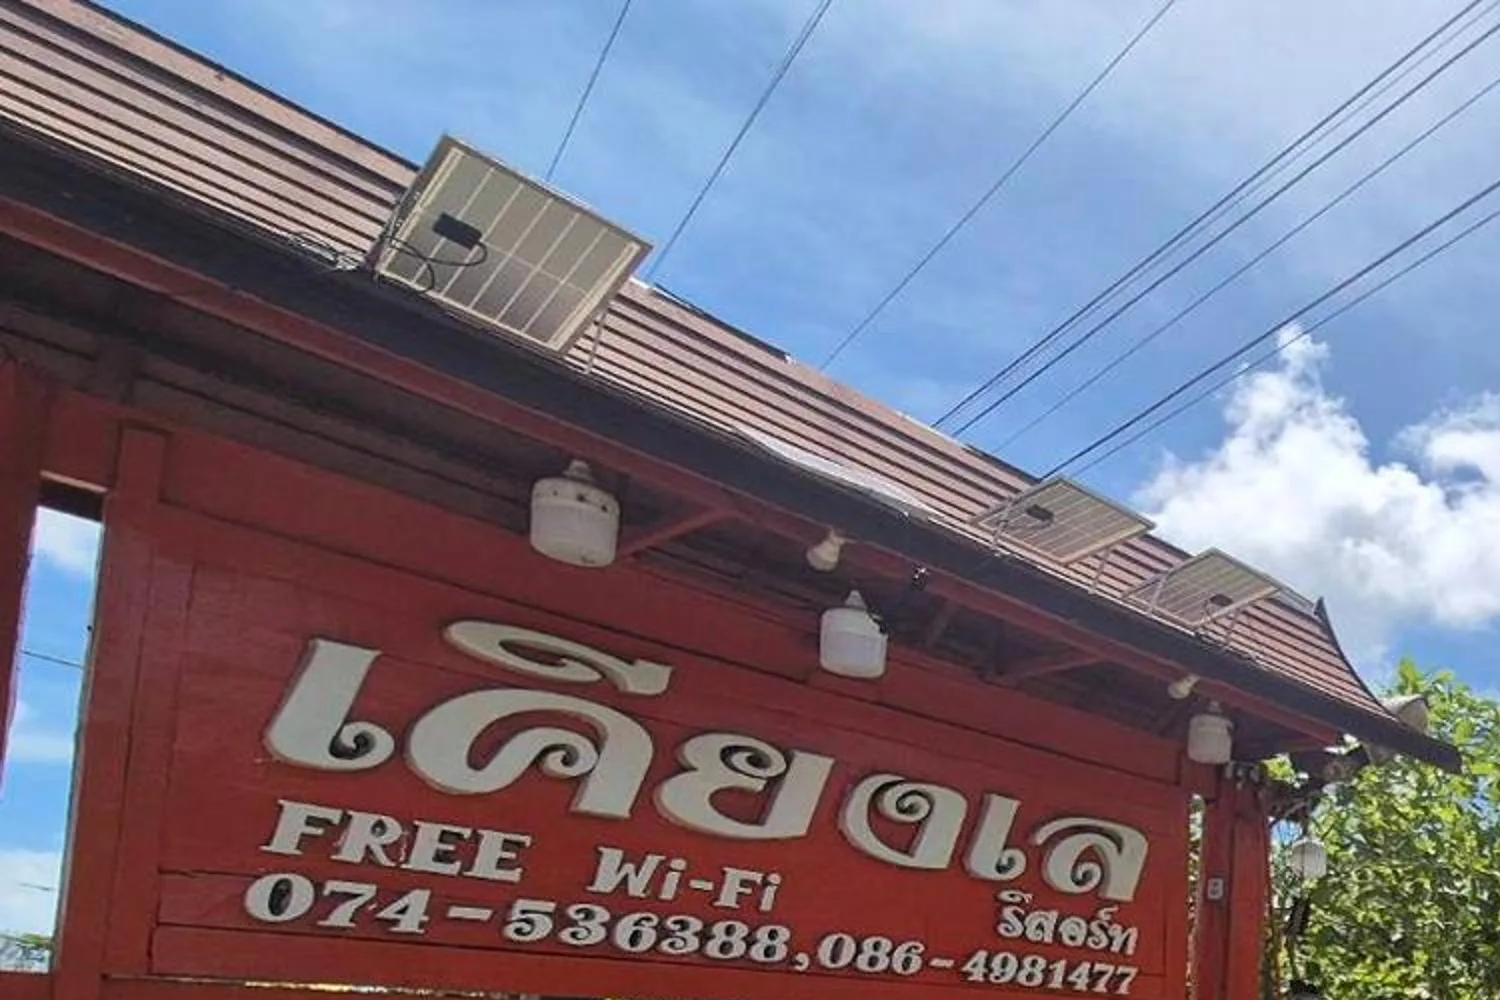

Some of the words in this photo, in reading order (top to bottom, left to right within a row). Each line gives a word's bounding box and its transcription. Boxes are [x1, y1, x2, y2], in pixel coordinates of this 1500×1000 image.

[260, 799, 532, 883] FREE
[586, 847, 782, 912] Wi-Fi
[996, 889, 1139, 956] รีสอร์ท
